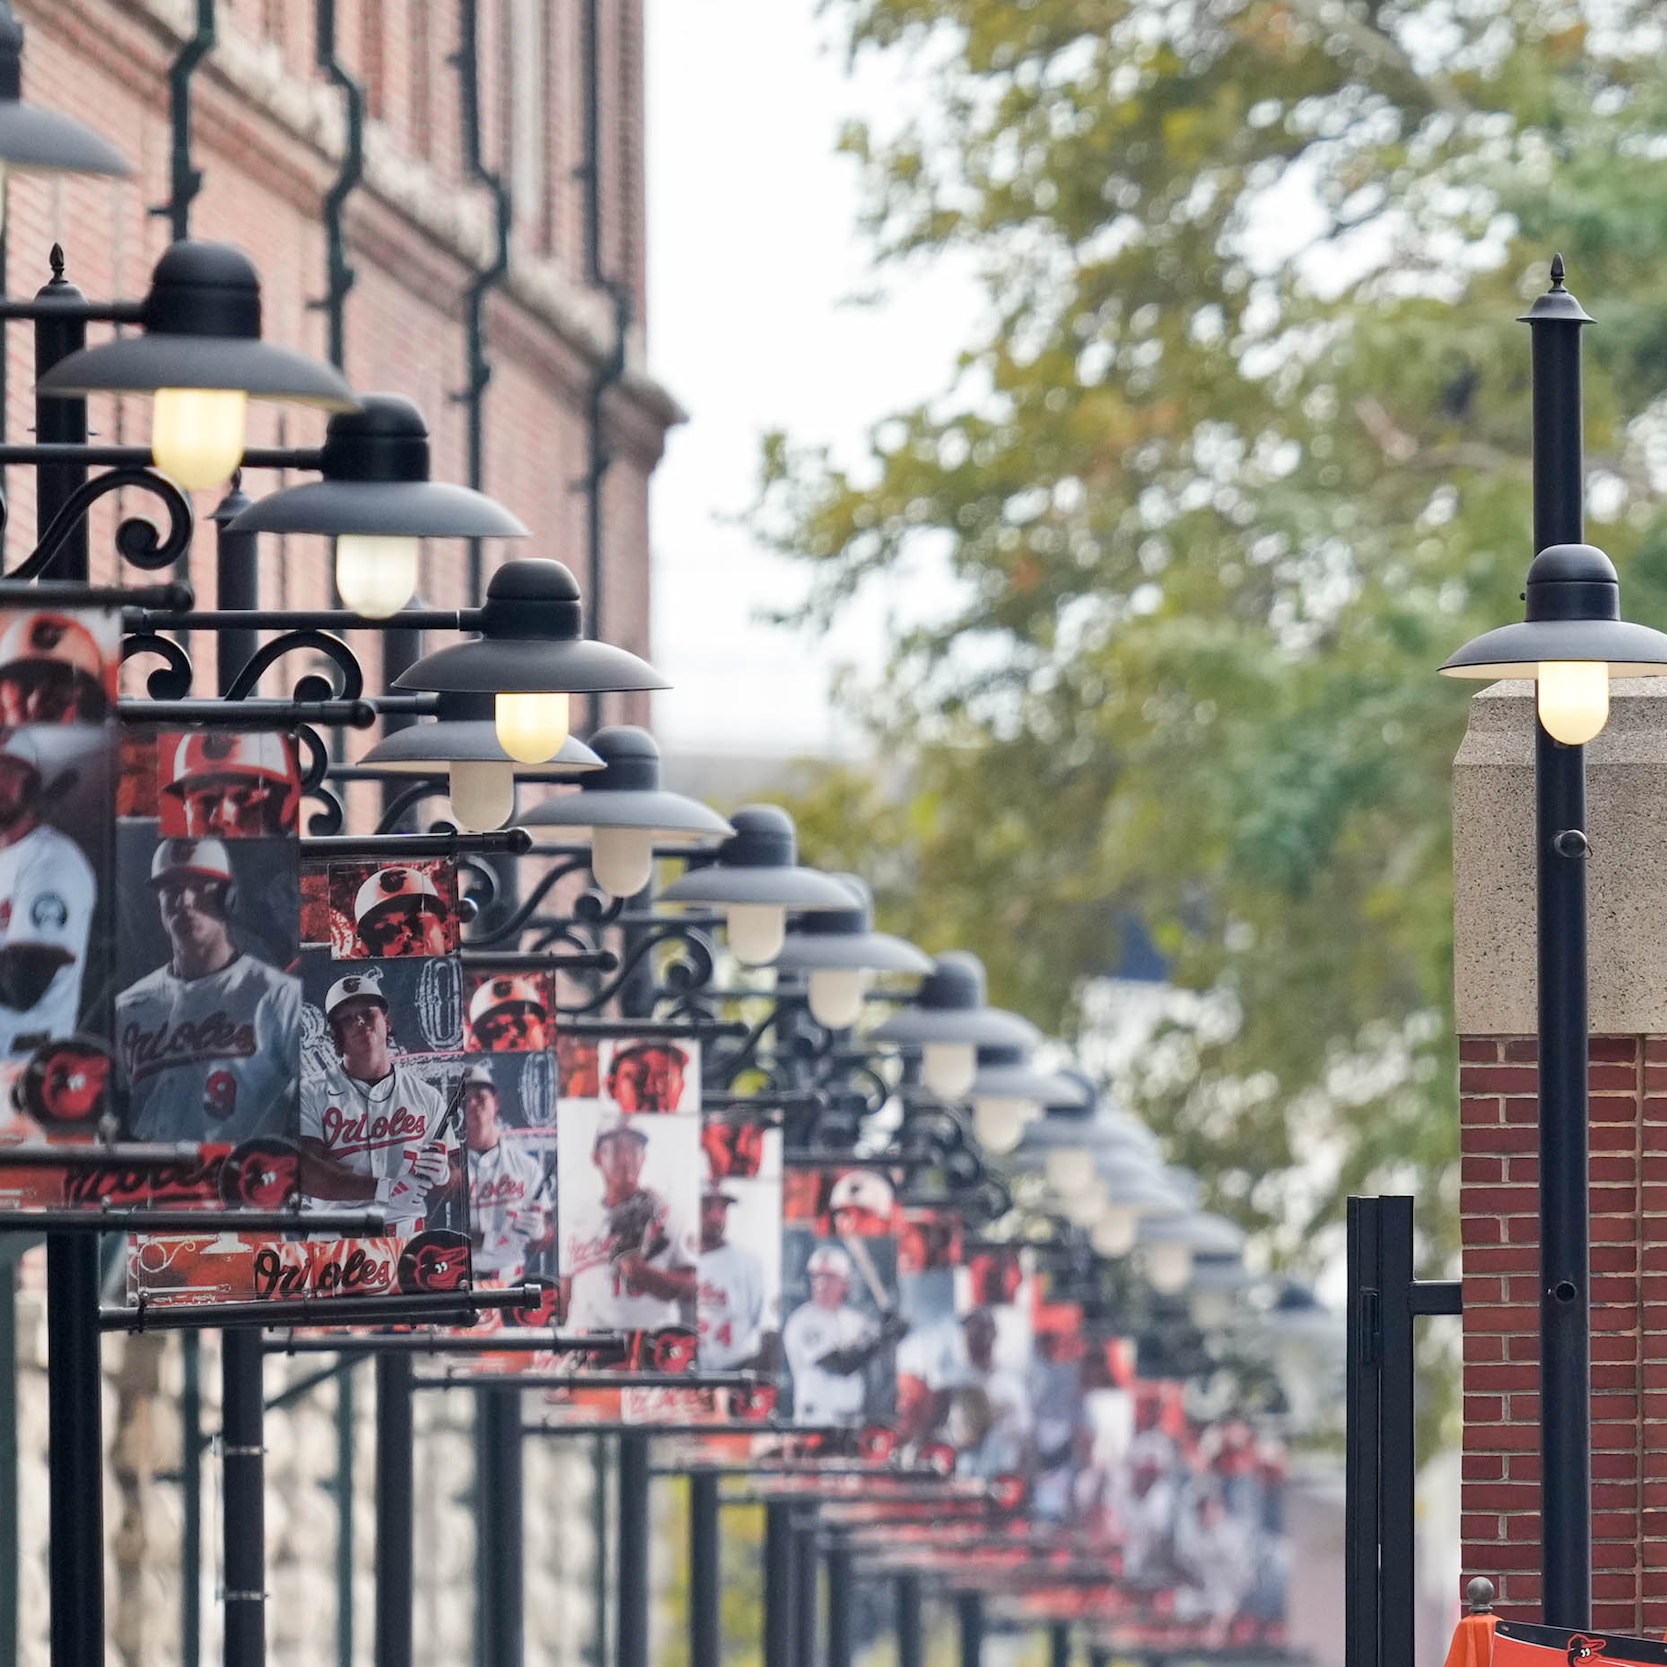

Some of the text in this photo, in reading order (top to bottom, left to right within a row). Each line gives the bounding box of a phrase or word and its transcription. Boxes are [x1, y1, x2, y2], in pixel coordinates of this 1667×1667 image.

[203, 1069, 238, 1121] 9
[323, 1106, 426, 1157] Orioles
[254, 1248, 391, 1300] Orioles
